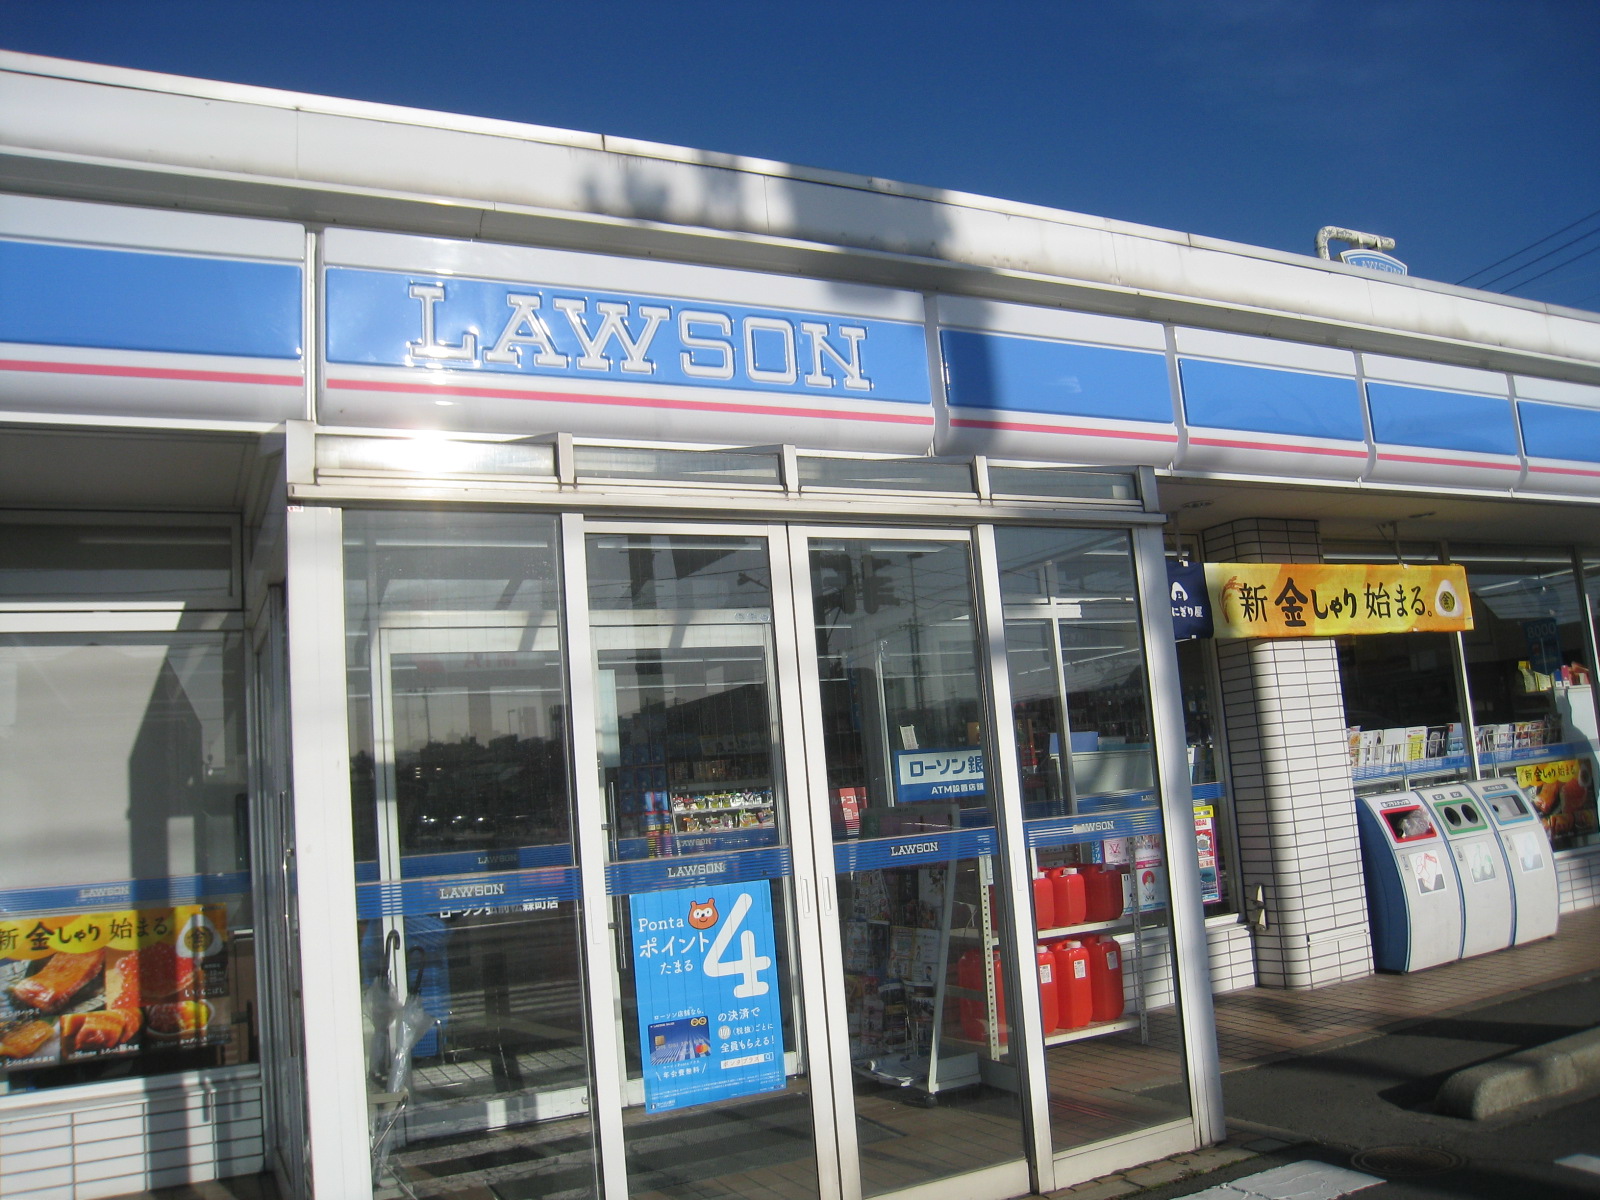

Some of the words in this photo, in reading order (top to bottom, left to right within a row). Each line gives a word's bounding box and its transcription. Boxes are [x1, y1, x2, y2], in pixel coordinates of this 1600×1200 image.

[407, 281, 875, 392] LAWSON
[910, 755, 984, 777] ローソン銀
[890, 841, 939, 857] LAWSON
[477, 854, 517, 865] LAWSON
[667, 861, 725, 878] LAWSON
[439, 883, 505, 900] LAWSON
[638, 917, 684, 933] Ponta
[639, 931, 710, 958] ポイント
[660, 959, 694, 975] たまる
[717, 1007, 761, 1022] の決済で
[663, 1066, 700, 1079] 年会費無料
